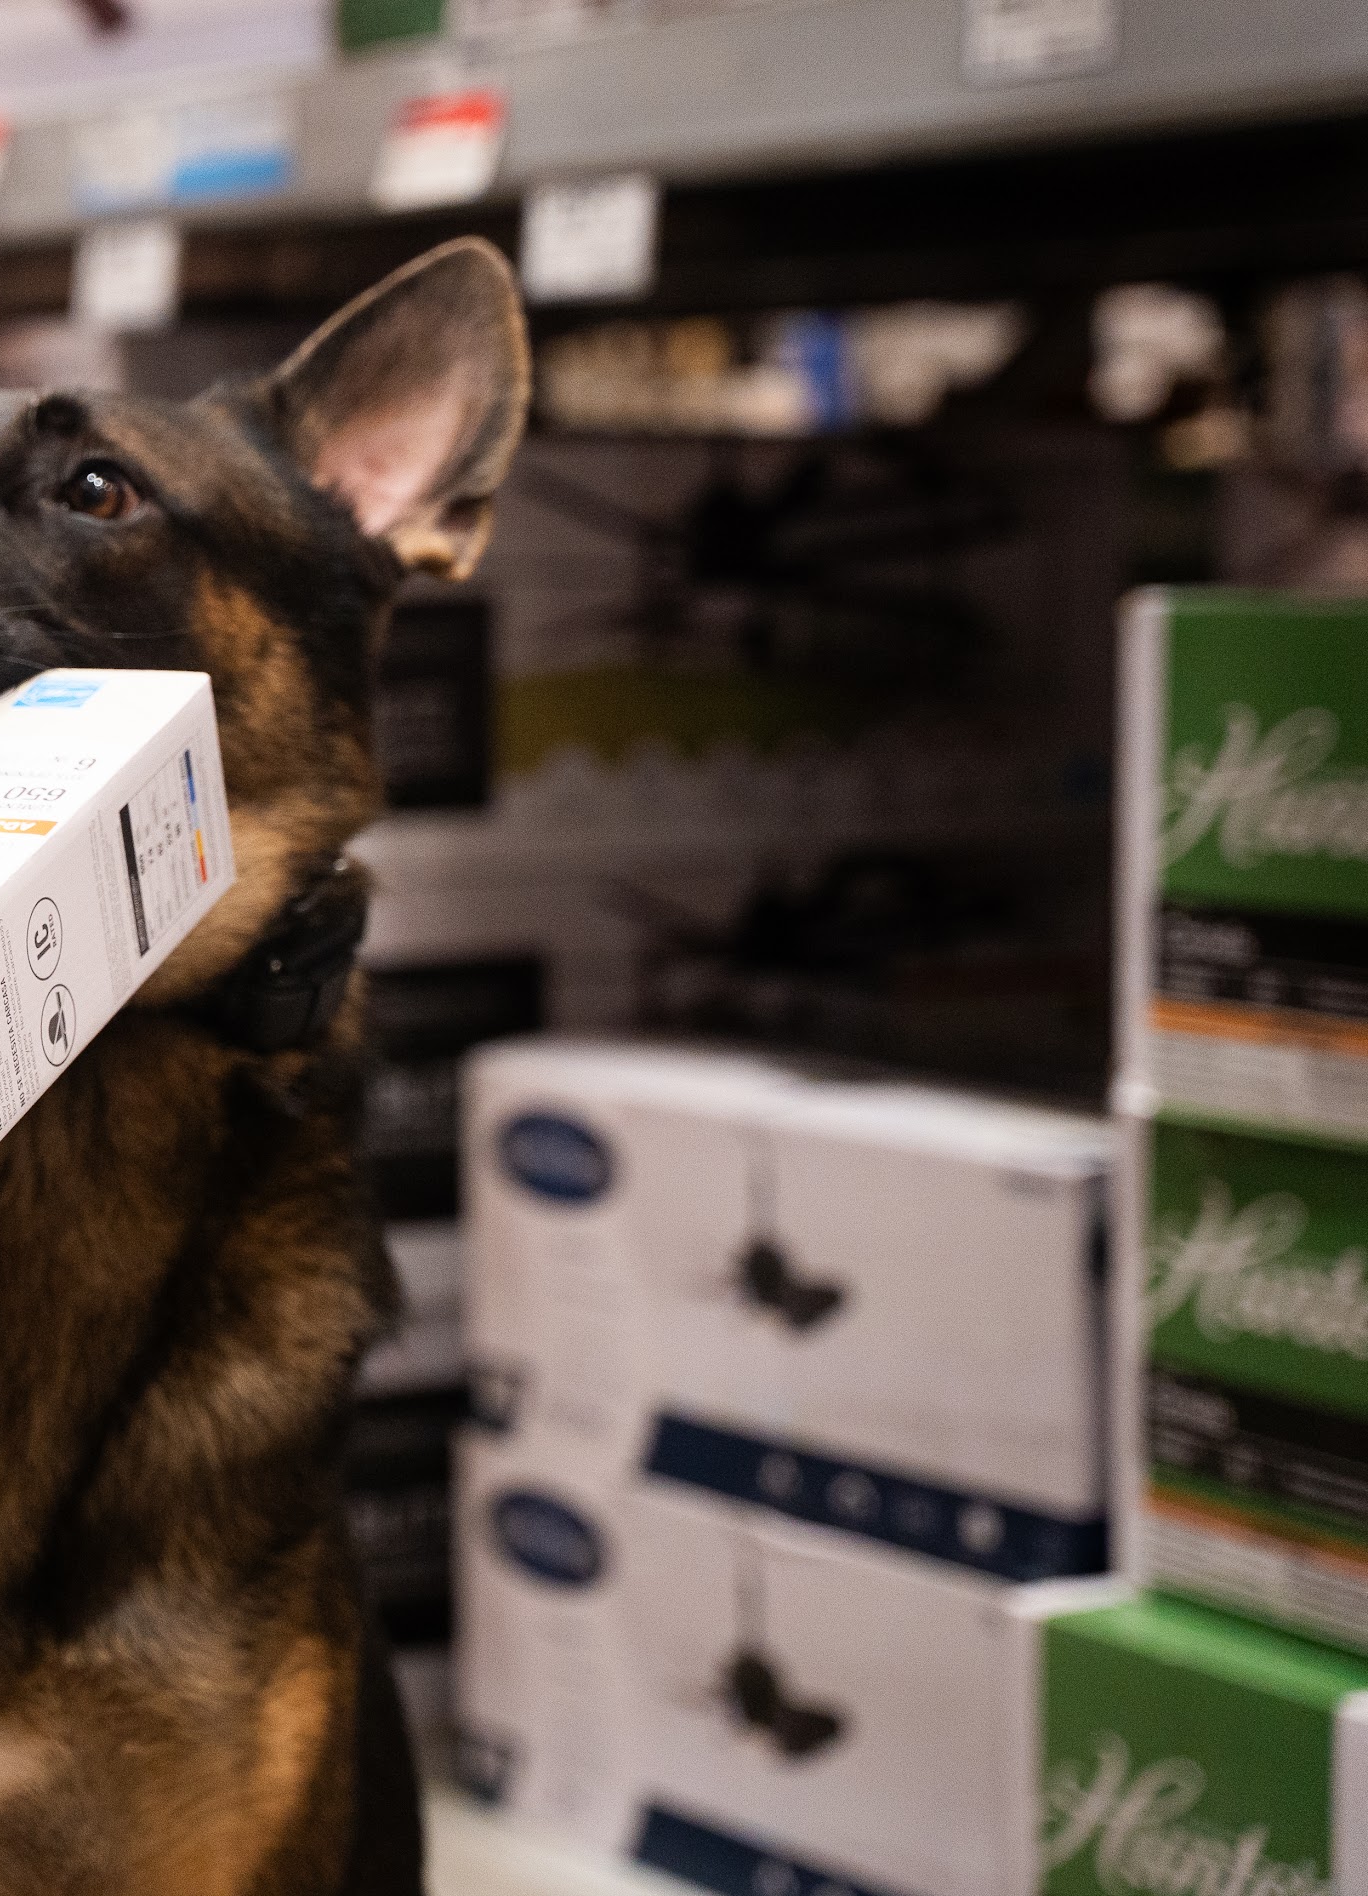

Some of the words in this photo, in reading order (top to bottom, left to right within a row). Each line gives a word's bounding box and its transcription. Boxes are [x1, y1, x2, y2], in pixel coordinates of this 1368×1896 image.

[74, 758, 97, 772] 6
[2, 786, 67, 802] 650
[35, 924, 51, 960] IC
[49, 914, 57, 948] RATED
[1, 978, 12, 1025] CARCASA
[9, 1027, 21, 1076] NECESITA
[17, 1078, 24, 1091] SE
[20, 1092, 26, 1108] NO
